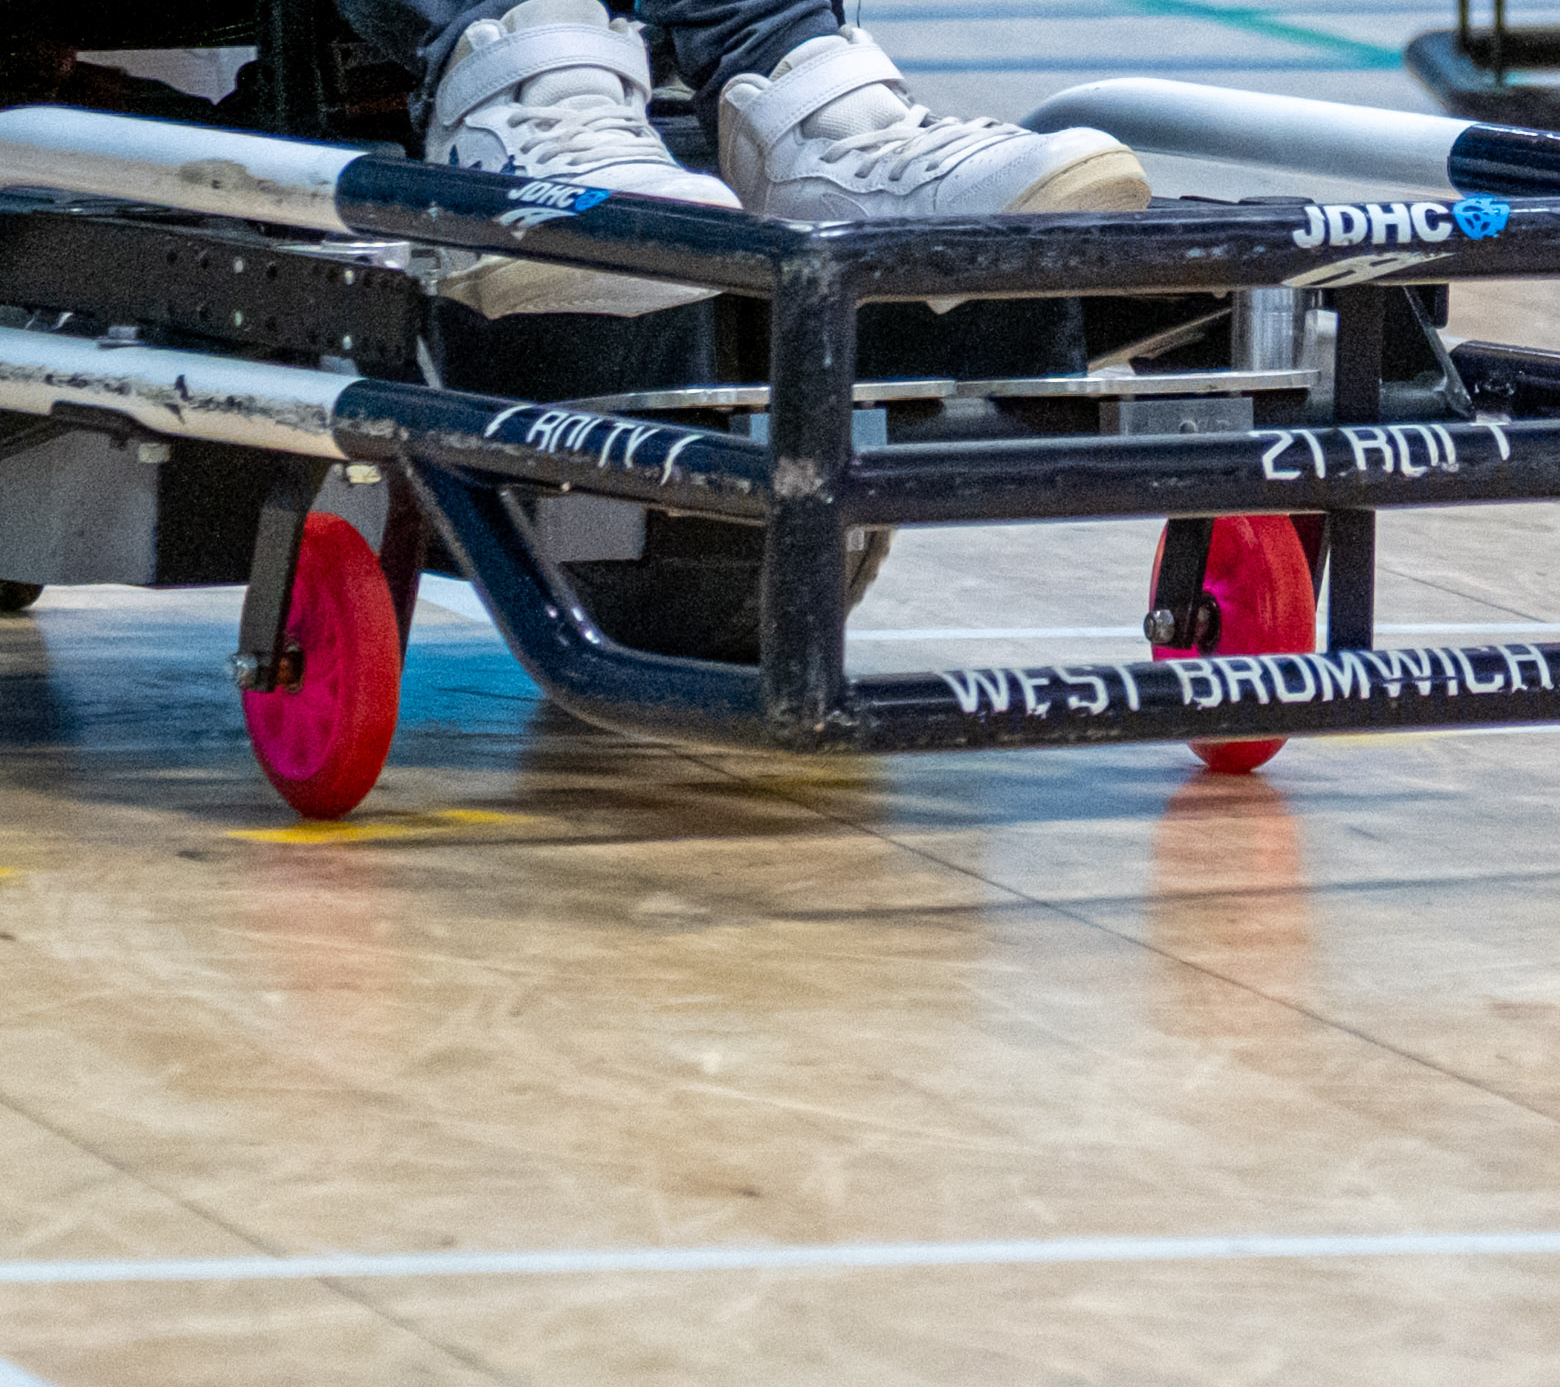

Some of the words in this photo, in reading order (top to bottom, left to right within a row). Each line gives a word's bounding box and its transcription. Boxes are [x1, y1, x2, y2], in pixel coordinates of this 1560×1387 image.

[507, 181, 586, 209] JDHC
[1292, 201, 1453, 249] JDHC
[1248, 428, 1327, 480] 21
[941, 663, 1146, 717] WEST
[1164, 642, 1555, 710] BROMWICH
